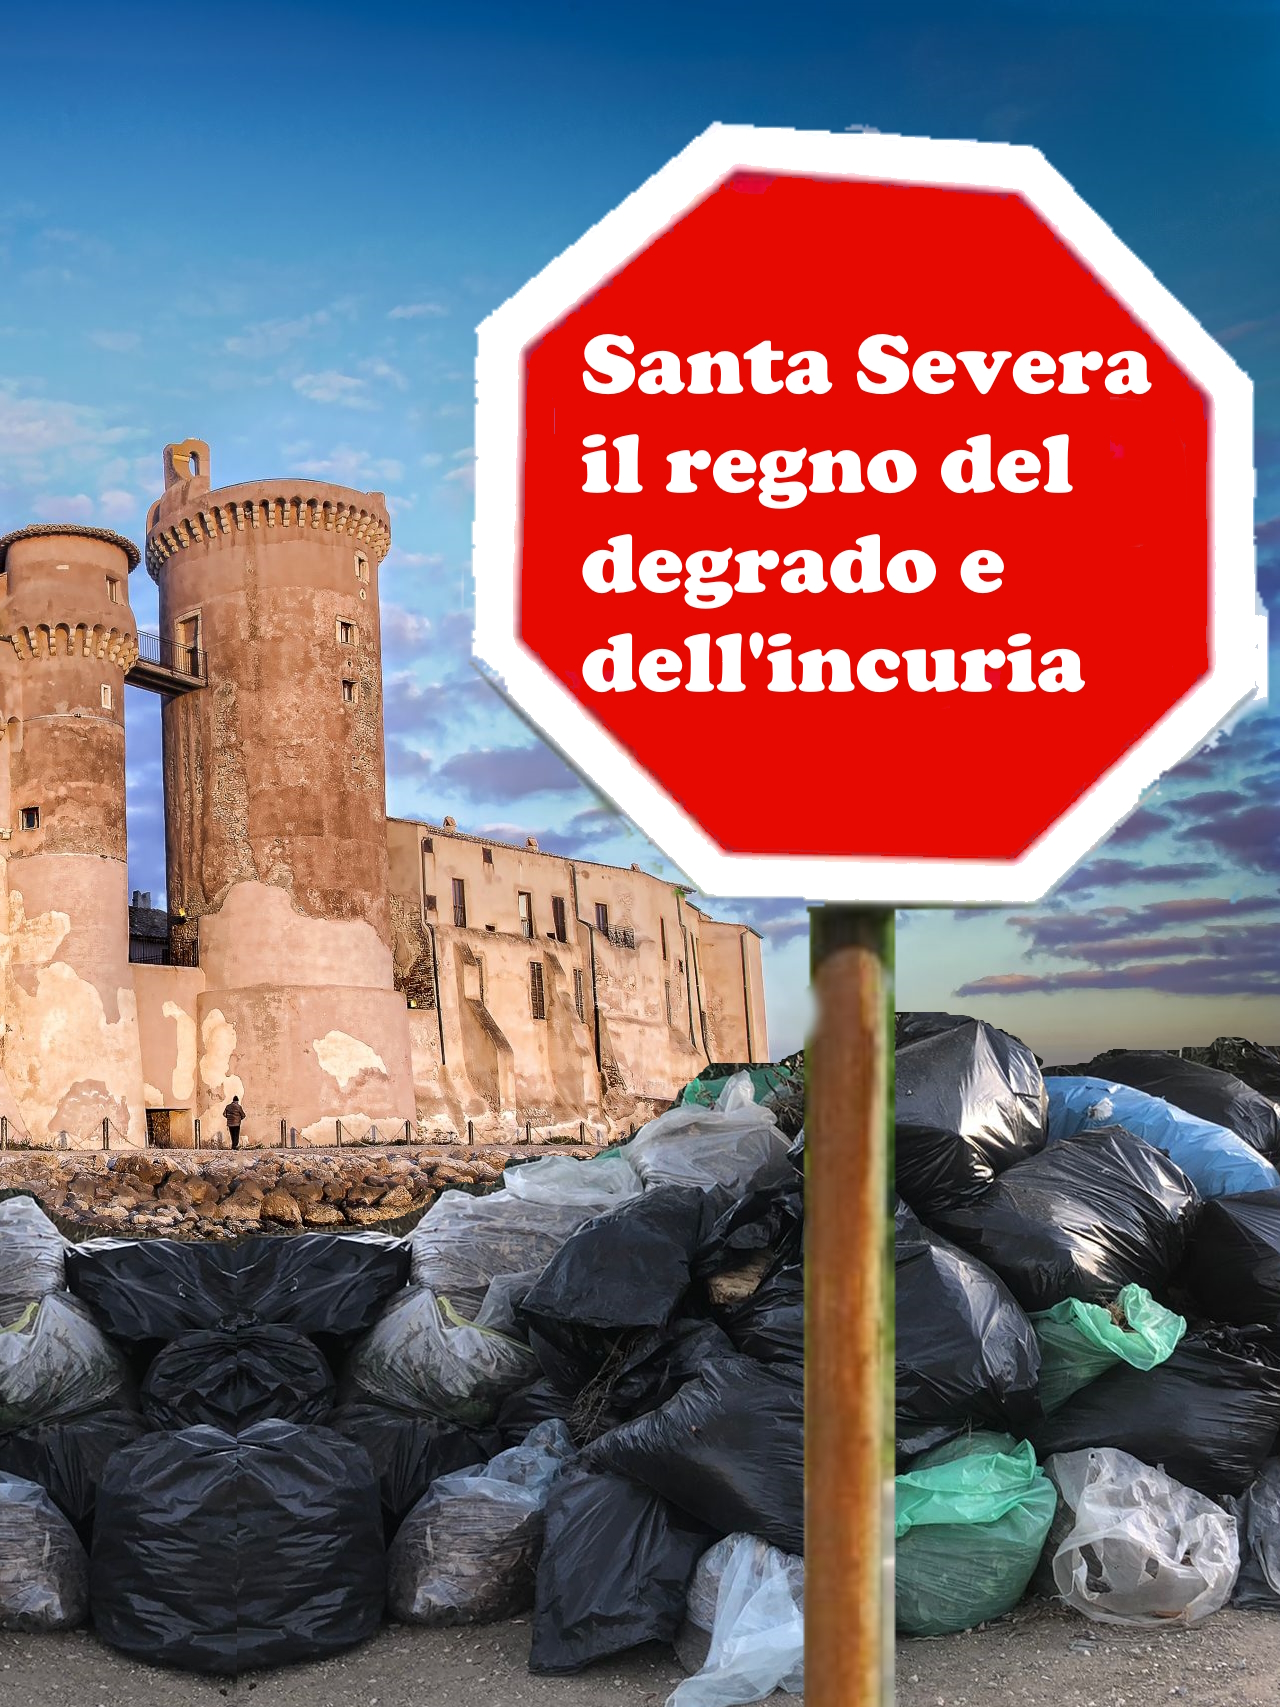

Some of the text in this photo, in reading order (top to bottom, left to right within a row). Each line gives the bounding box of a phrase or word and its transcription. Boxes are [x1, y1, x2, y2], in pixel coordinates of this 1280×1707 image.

[582, 334, 1153, 395] Santa Severa
[582, 434, 1074, 510] il regno del
[582, 534, 1005, 610] degrado e
[582, 632, 1086, 693] dell'incuria
